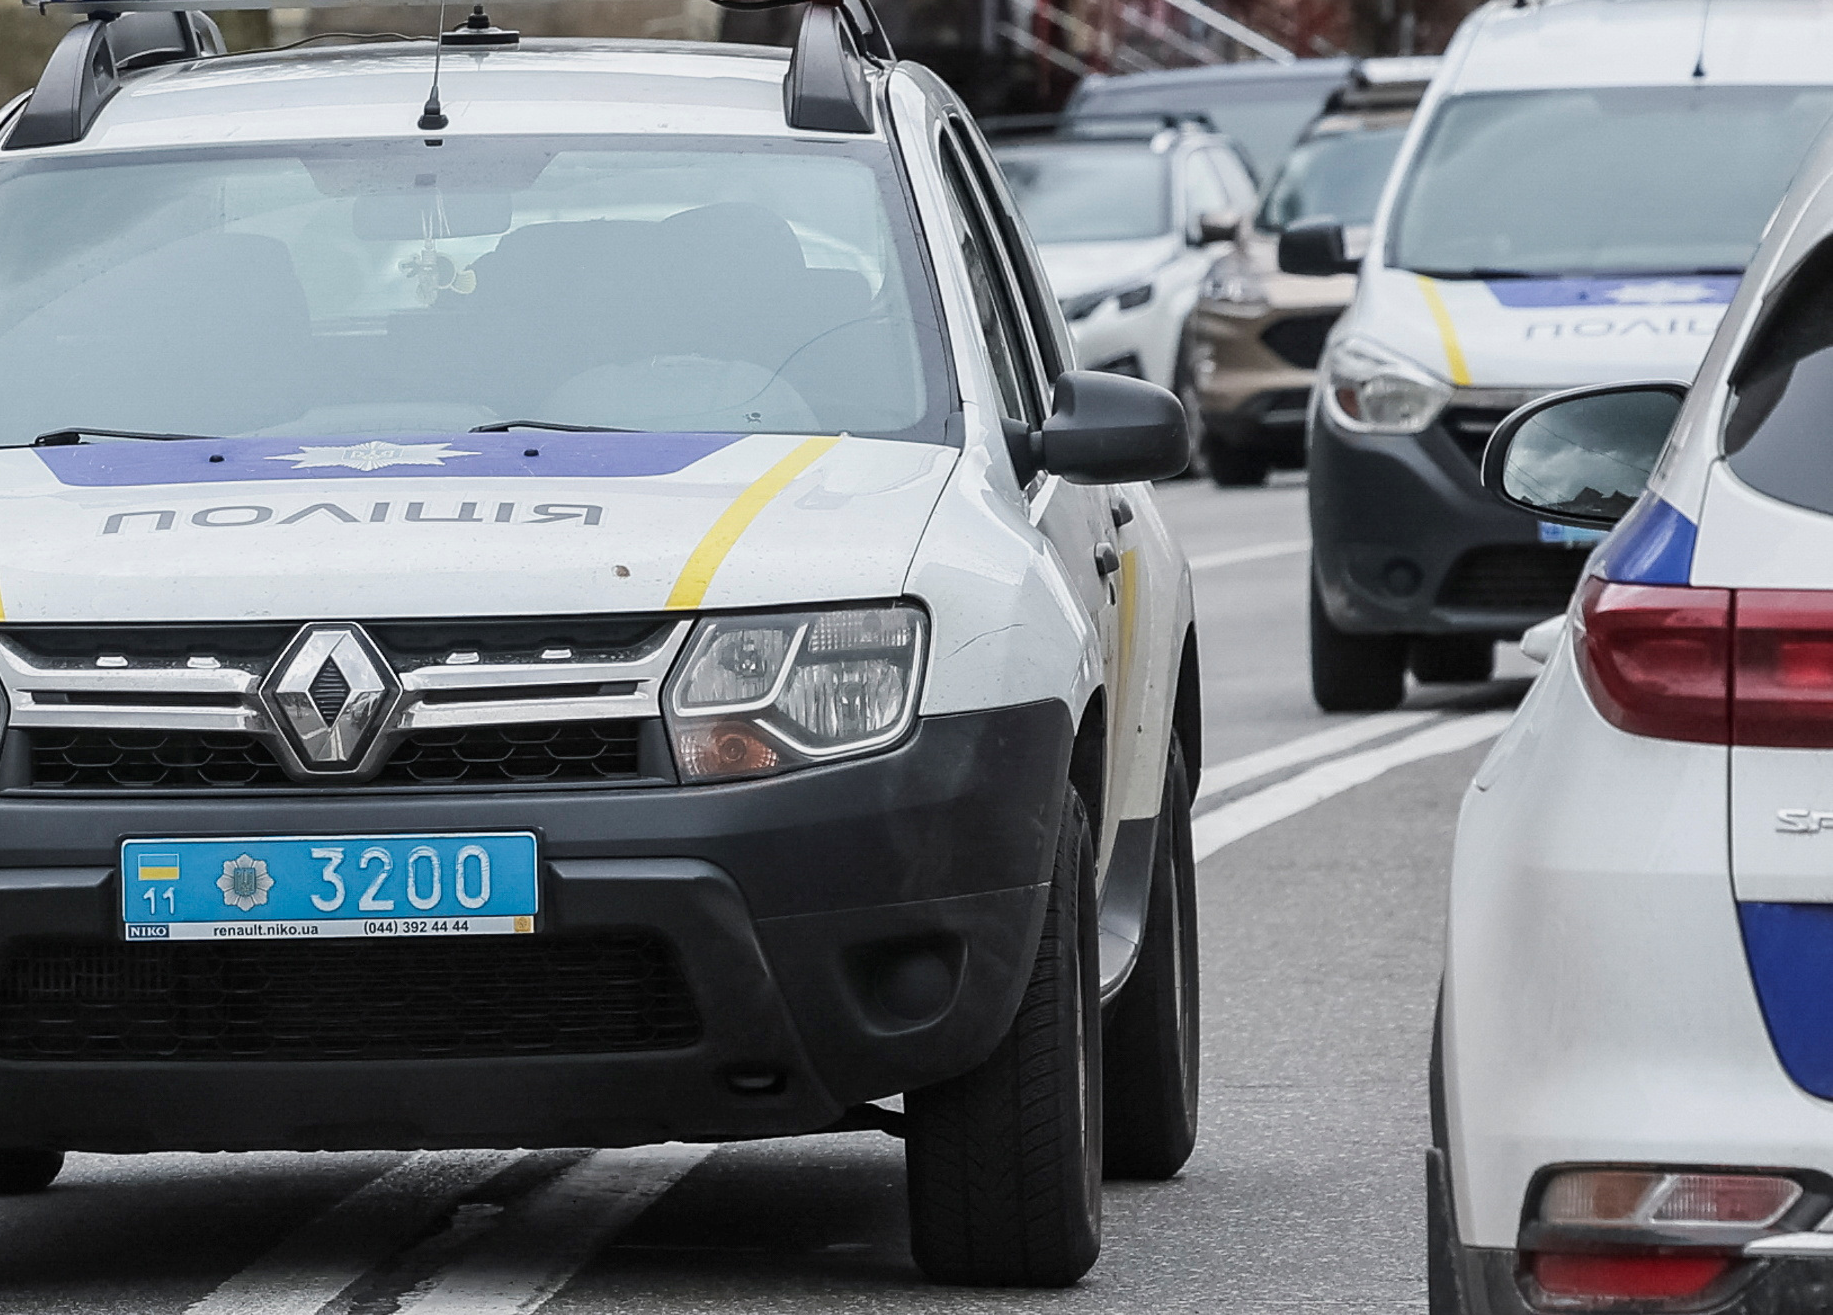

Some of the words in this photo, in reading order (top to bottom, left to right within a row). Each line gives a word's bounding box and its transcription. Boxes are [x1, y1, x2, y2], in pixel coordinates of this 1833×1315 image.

[102, 501, 604, 535] ПОЛІЦІЯ
[310, 845, 491, 912] 3200
[143, 887, 175, 915] 11
[129, 926, 167, 937] NIKO
[213, 923, 319, 936] renault.niko.ua
[364, 920, 398, 935] (044)
[402, 921, 427, 933] 392
[431, 920, 448, 932] 44
[452, 919, 469, 931] 44
